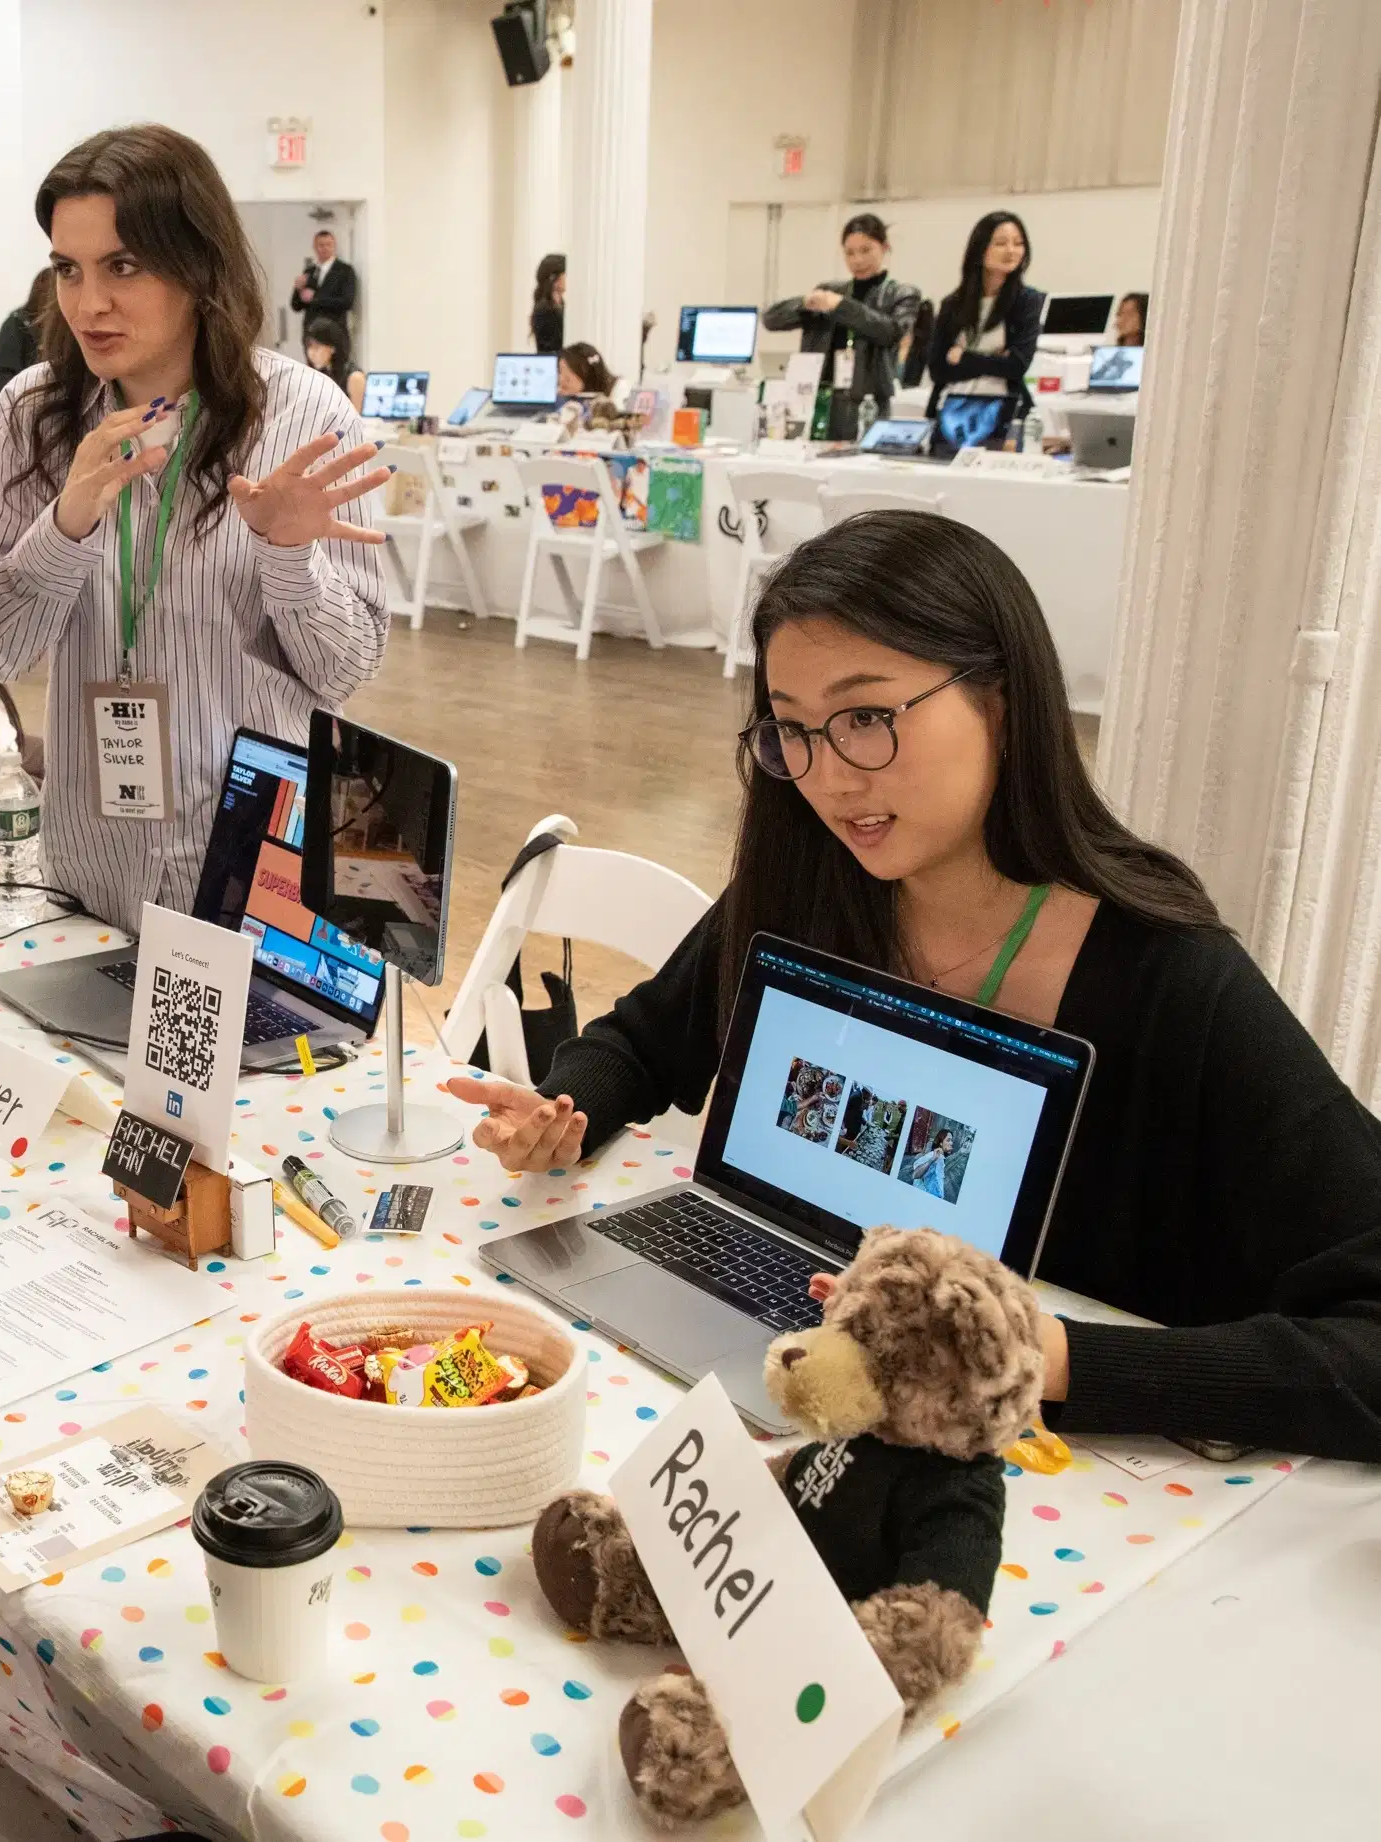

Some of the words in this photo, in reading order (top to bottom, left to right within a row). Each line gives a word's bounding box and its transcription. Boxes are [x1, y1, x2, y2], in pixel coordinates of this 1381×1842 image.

[110, 701, 146, 719] Hi!
[100, 737, 144, 749] TAYLOR
[103, 752, 145, 766] SILVER
[230, 771, 253, 787] SILVER
[231, 764, 257, 780] TAYLOR
[171, 948, 184, 960] Let's
[184, 953, 210, 969] Connect!
[115, 1115, 183, 1171] RACHEL
[107, 1140, 146, 1176] PAN
[82, 1226, 107, 1244] RACHEL
[105, 1240, 121, 1251] PAN
[824, 1239, 845, 1254] MacBook
[438, 1357, 472, 1398] SOUR
[452, 1348, 485, 1394] PATCH
[649, 1428, 774, 1640] Rachel
